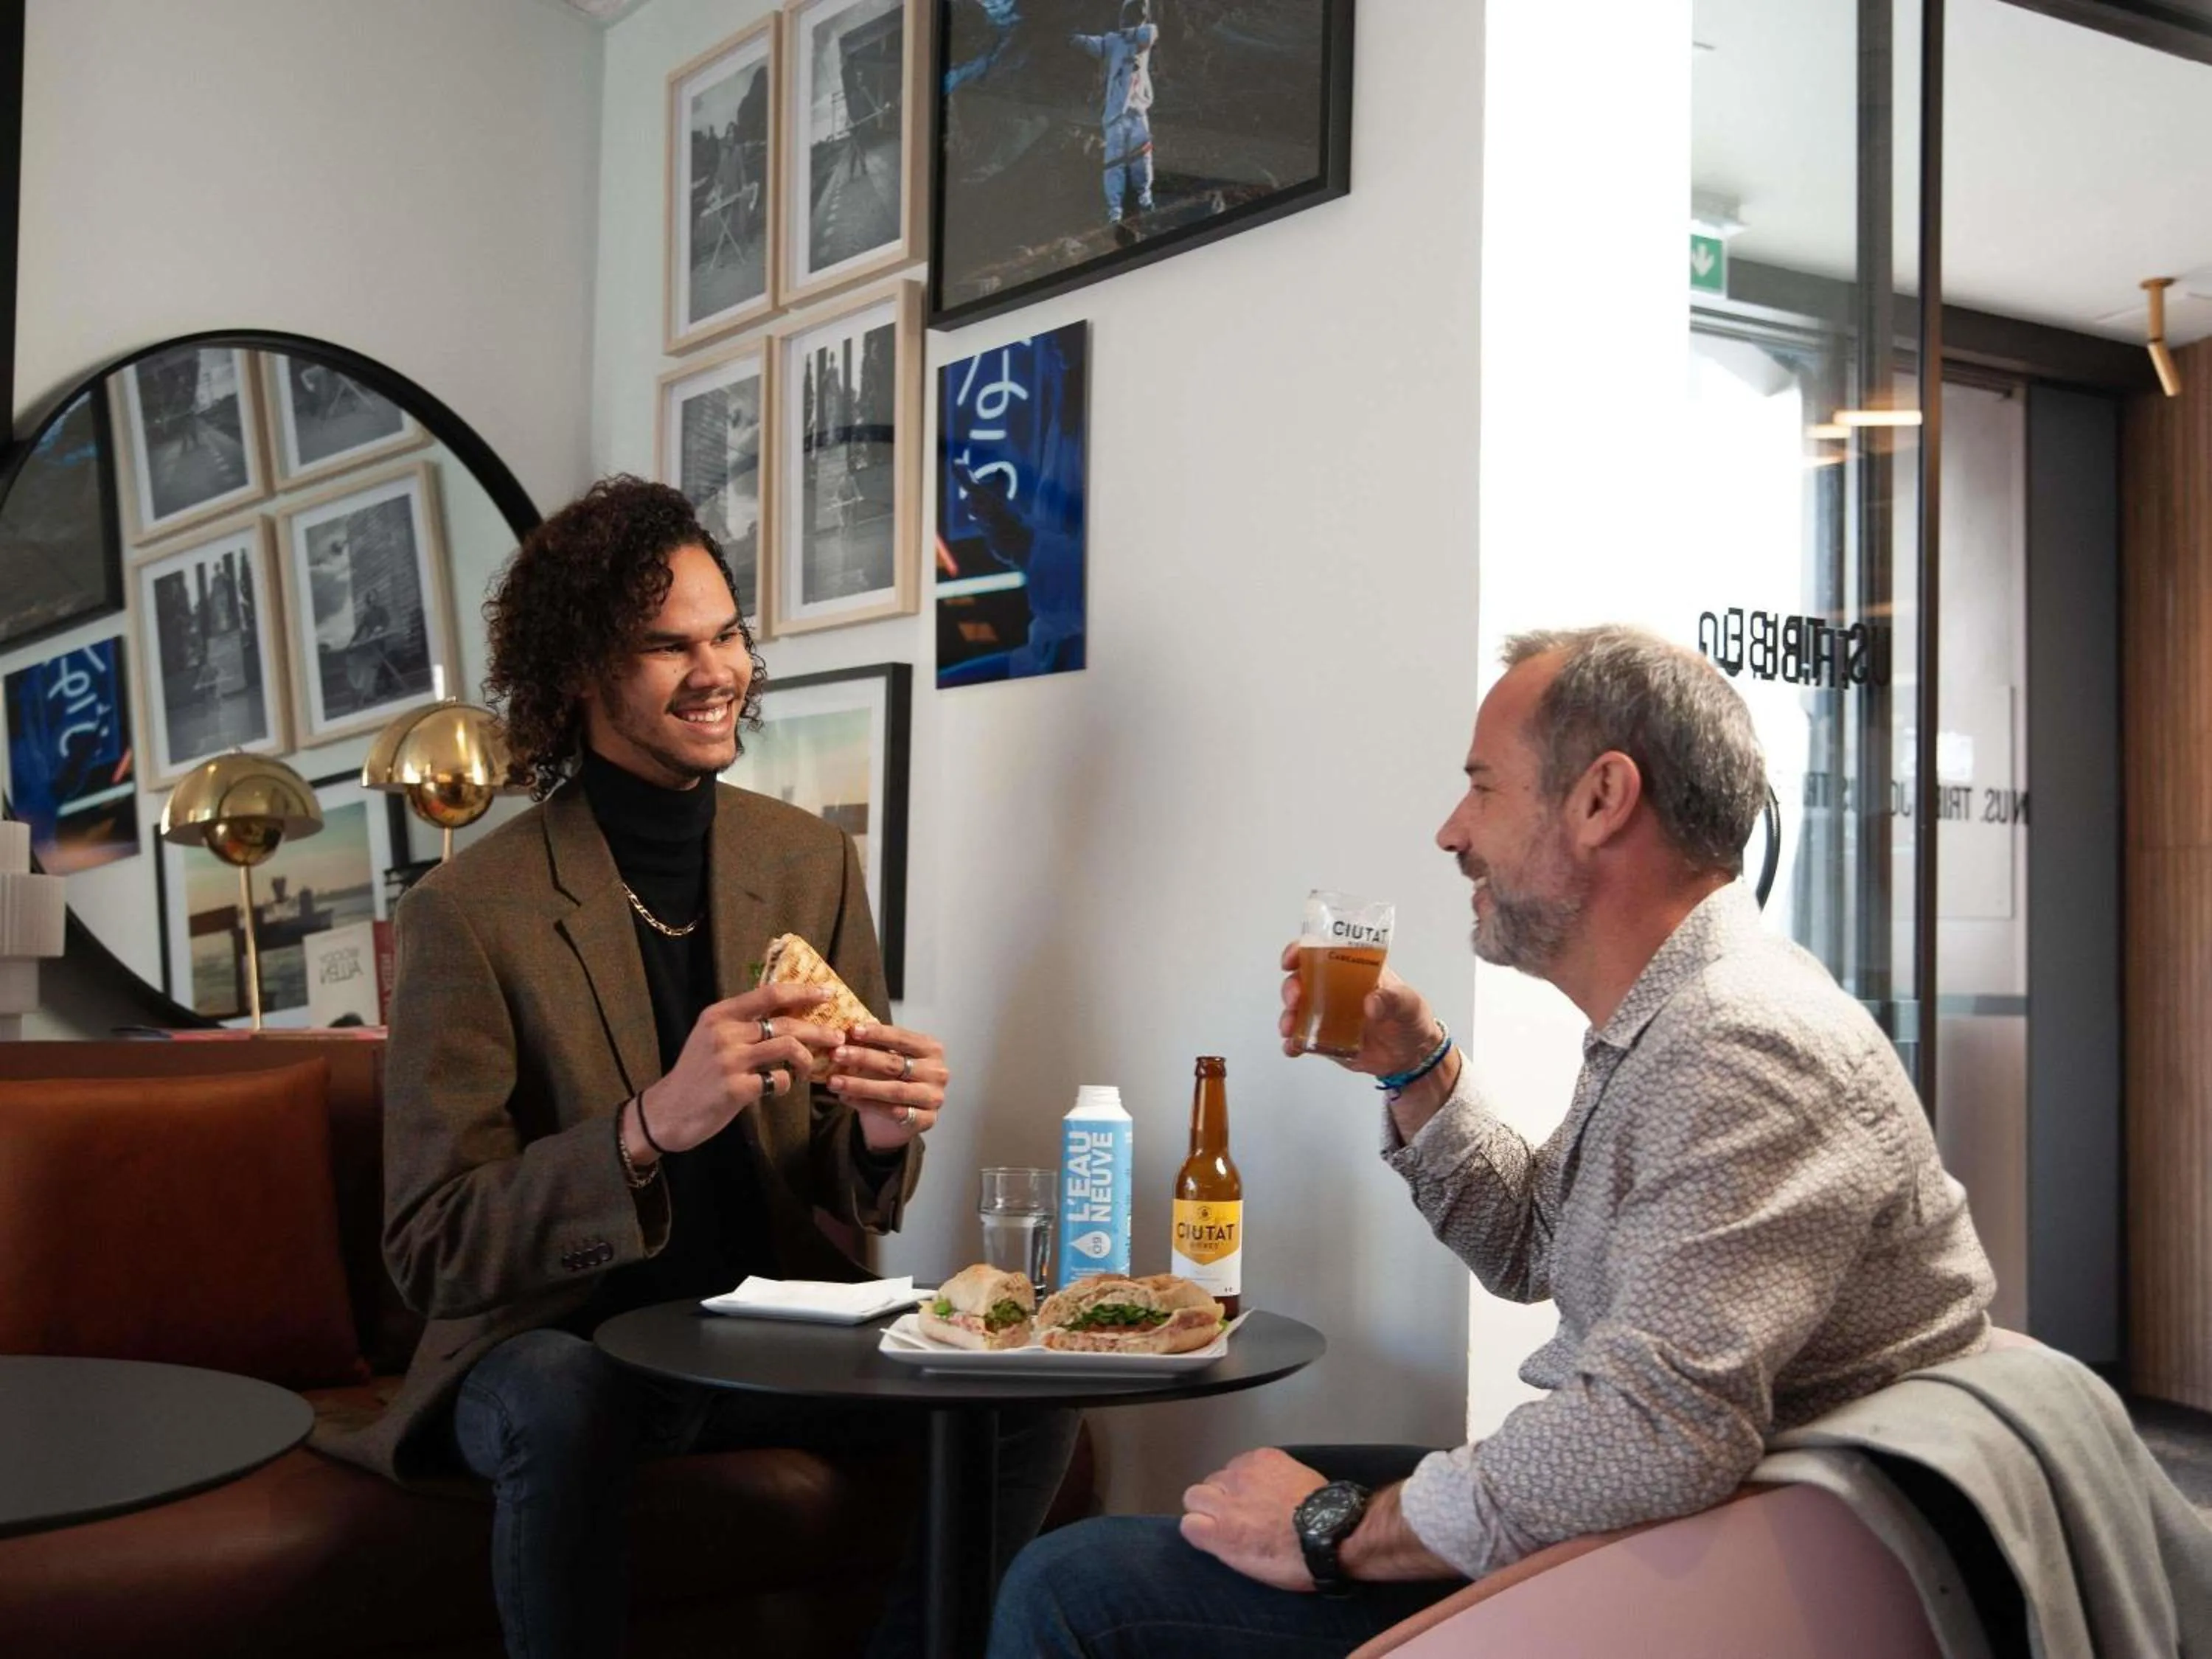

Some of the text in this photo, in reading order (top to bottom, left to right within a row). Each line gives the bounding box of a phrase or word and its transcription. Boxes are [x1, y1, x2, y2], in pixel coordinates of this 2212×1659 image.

[1333, 921, 1388, 943] CIUTAT
[1067, 1131, 1091, 1222] L'EAU
[1091, 1132, 1113, 1222] NEUVE
[1177, 1222, 1235, 1240] CIUTAT
